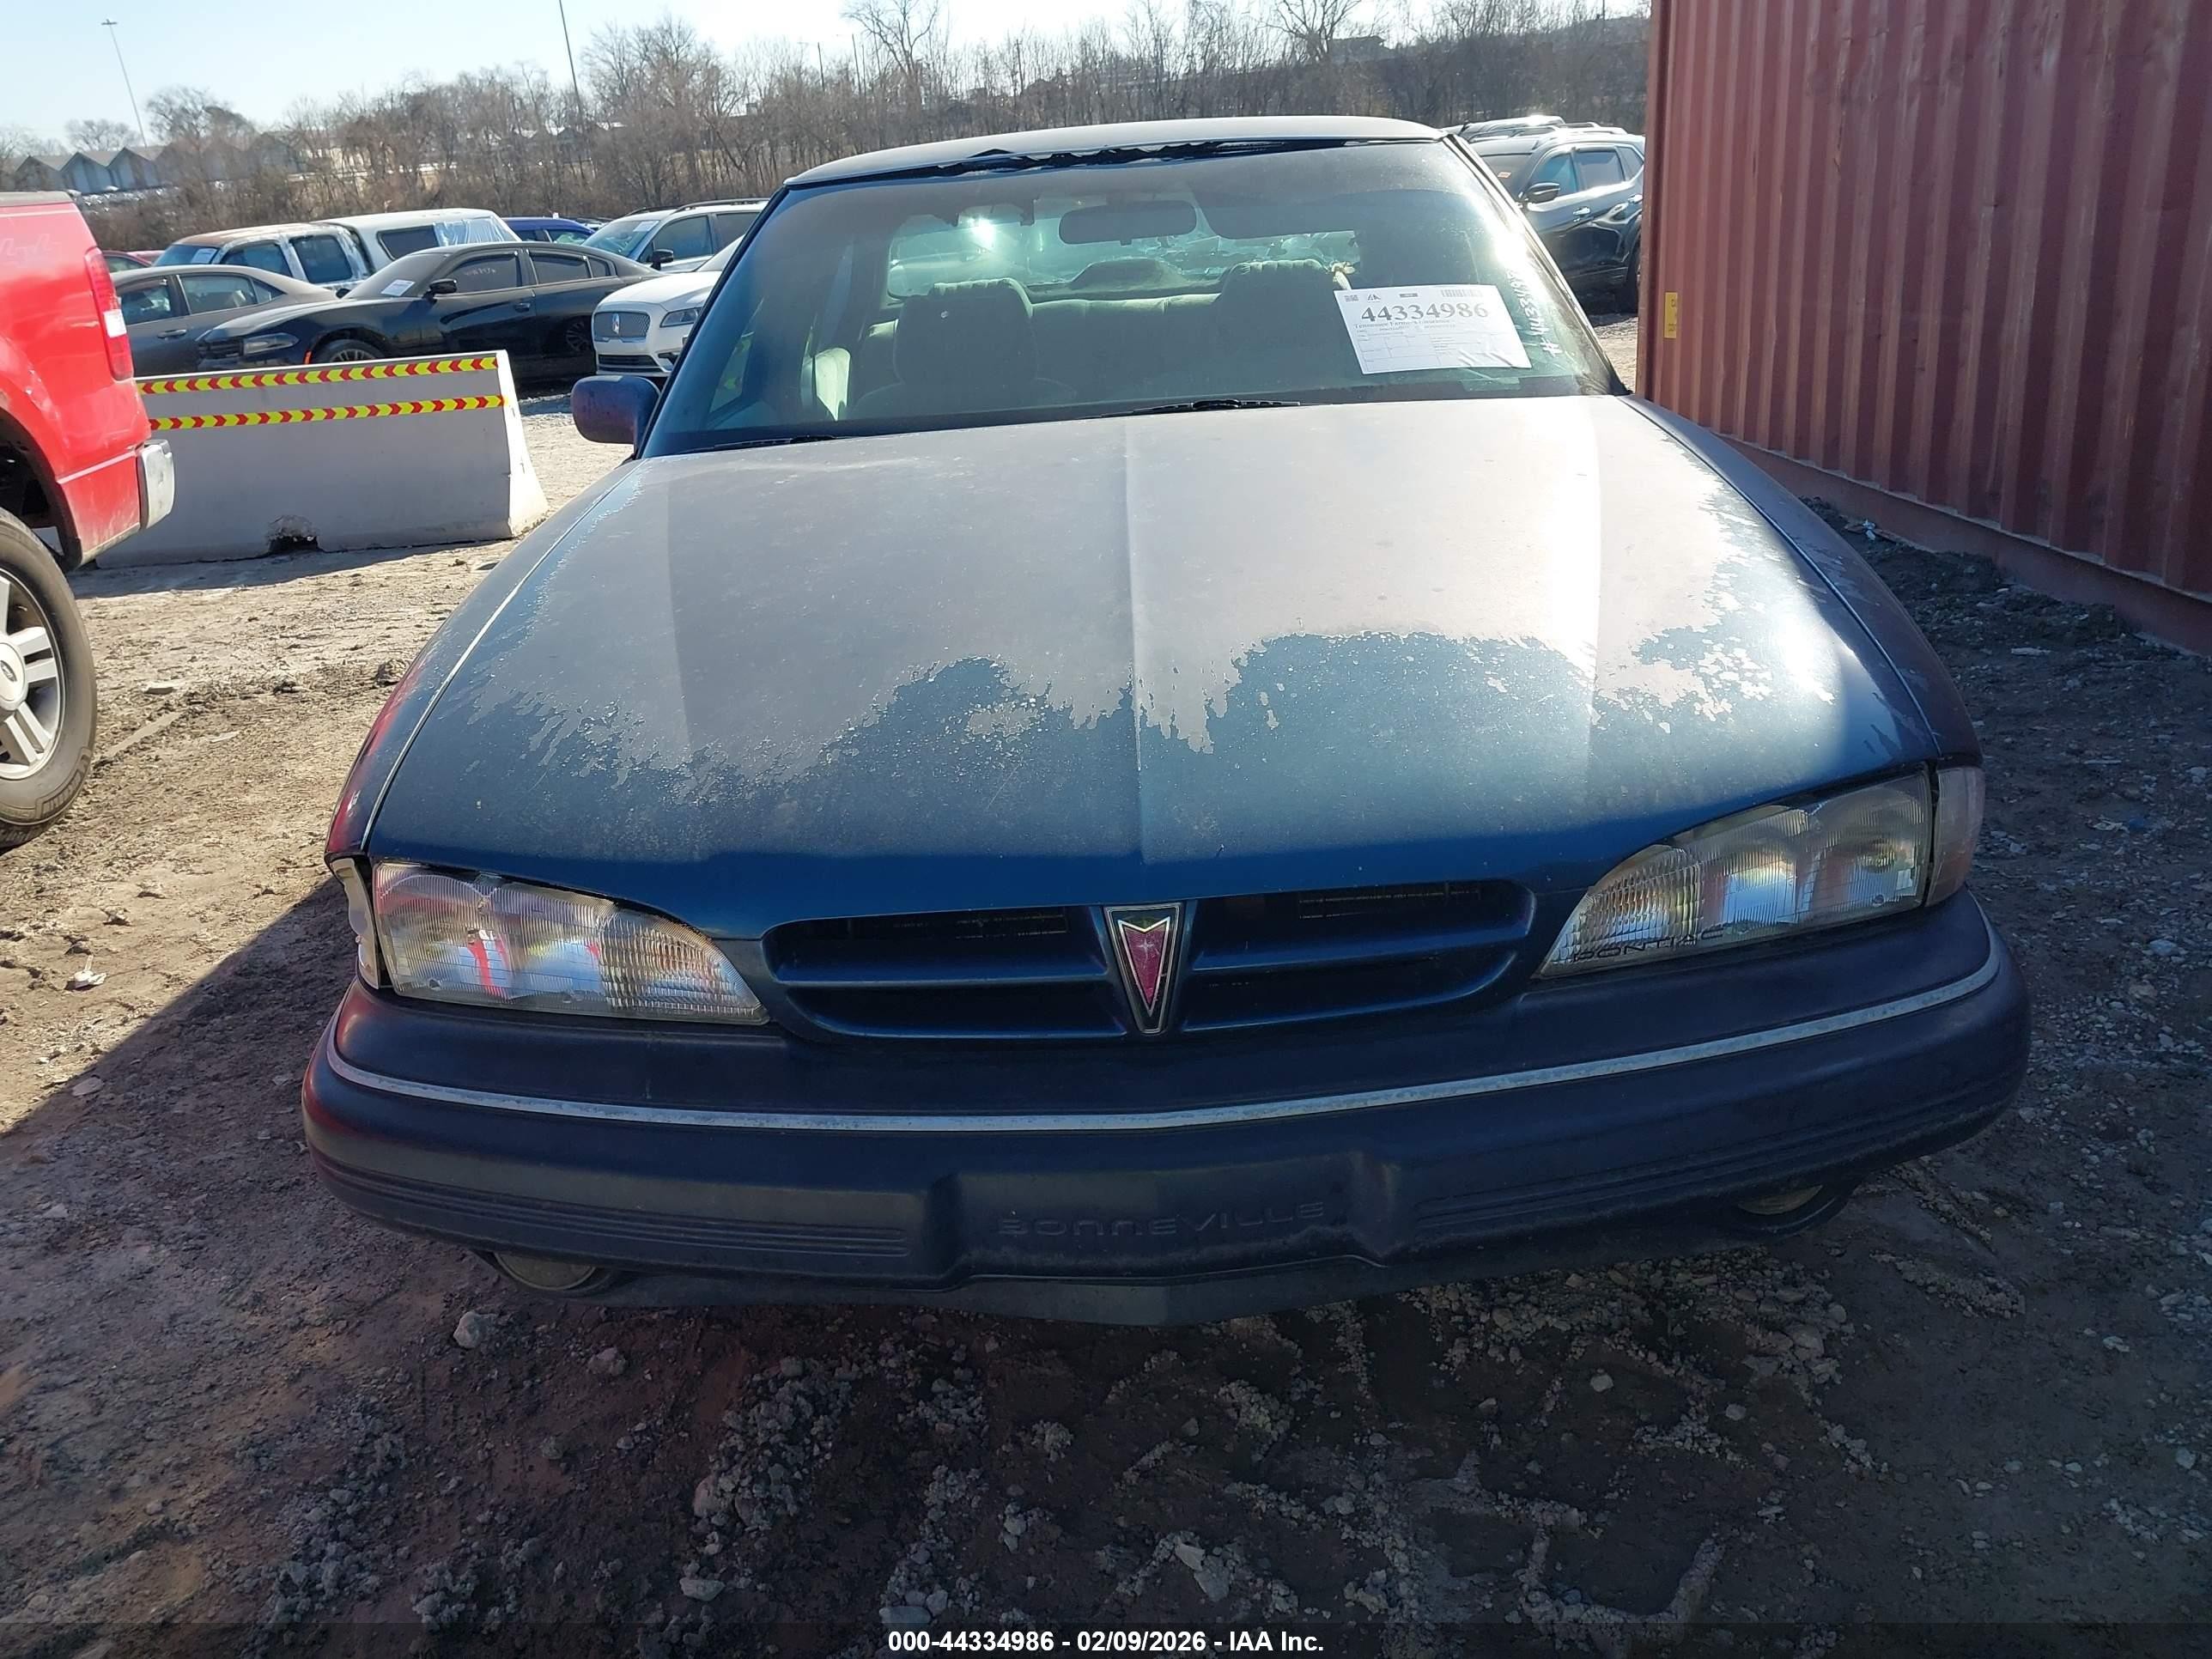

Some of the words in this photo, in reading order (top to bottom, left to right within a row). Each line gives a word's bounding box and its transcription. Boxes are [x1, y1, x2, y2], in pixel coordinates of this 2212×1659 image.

[1361, 302, 1489, 322] 44334986
[1573, 923, 1724, 963] PONTIAC
[998, 1201, 1324, 1237] BONNEVILLE
